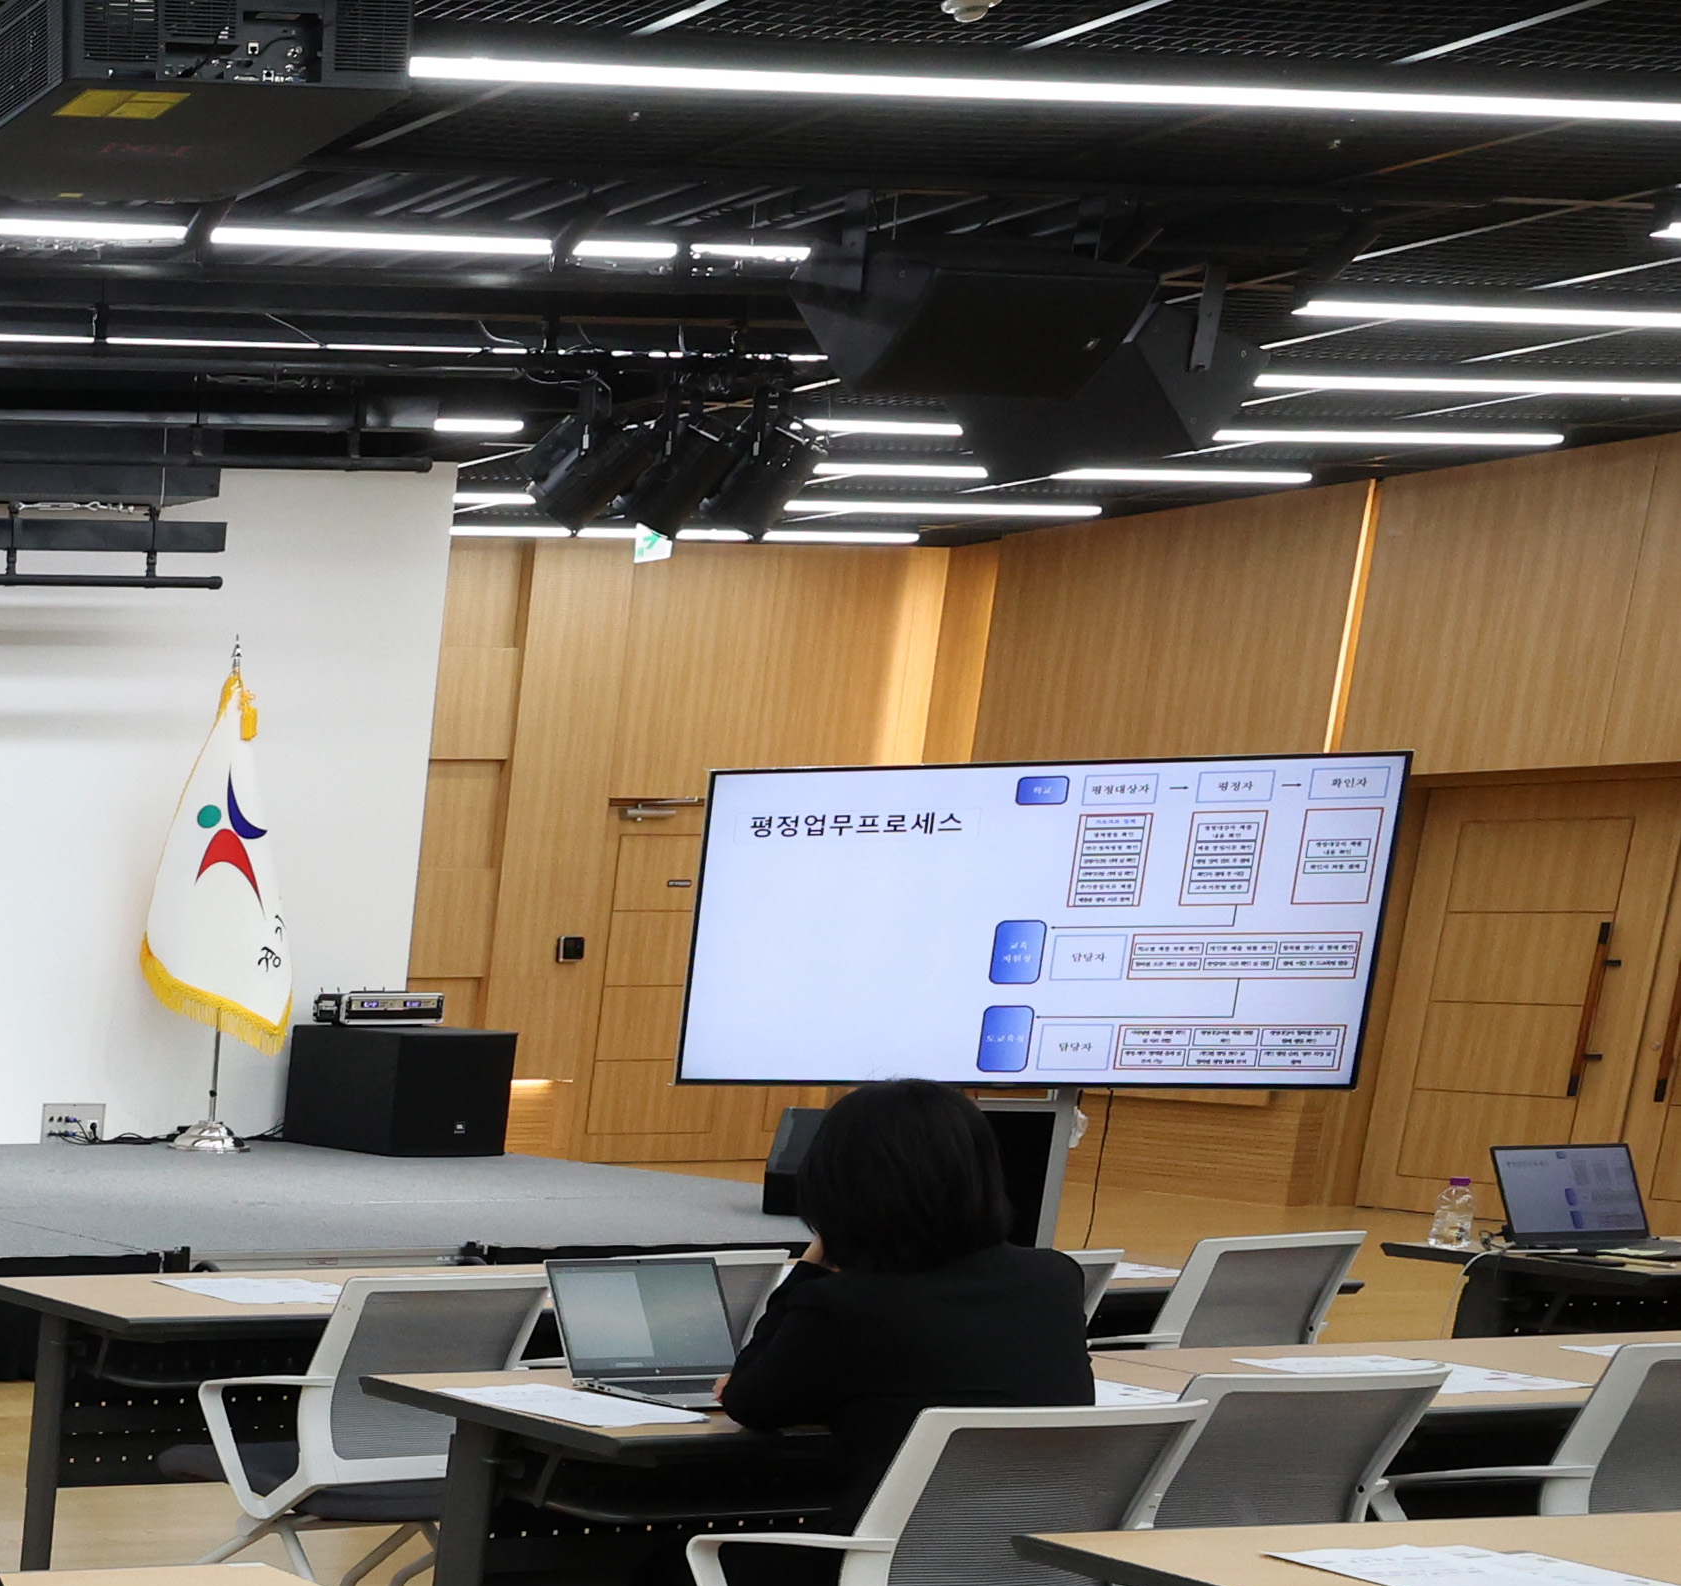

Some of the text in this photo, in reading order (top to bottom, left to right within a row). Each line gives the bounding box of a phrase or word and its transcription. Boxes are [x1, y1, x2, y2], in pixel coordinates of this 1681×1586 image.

[1217, 780, 1254, 792] 평정자
[1331, 776, 1368, 789] 확인자
[1091, 783, 1150, 795] 평정대상자
[749, 812, 963, 839] 평정업무프로세스
[1071, 952, 1107, 963] 담당자
[1058, 1041, 1093, 1053] 담당자
